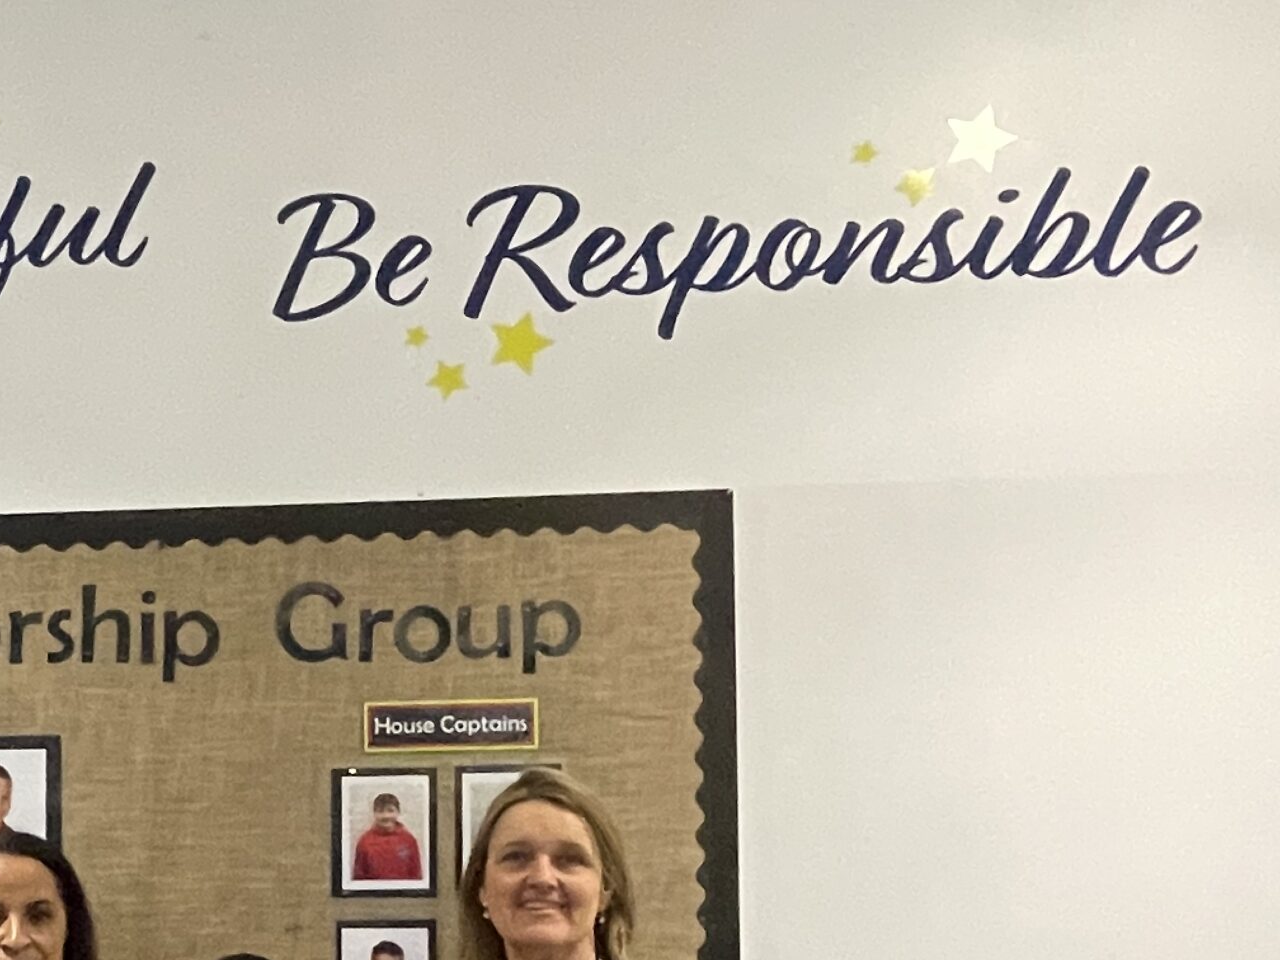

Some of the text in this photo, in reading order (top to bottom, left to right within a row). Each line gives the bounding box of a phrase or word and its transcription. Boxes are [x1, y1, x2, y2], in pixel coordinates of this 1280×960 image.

[271, 165, 1203, 341] Be Responsible
[274, 581, 582, 676] Group
[373, 714, 529, 737] House Captains
